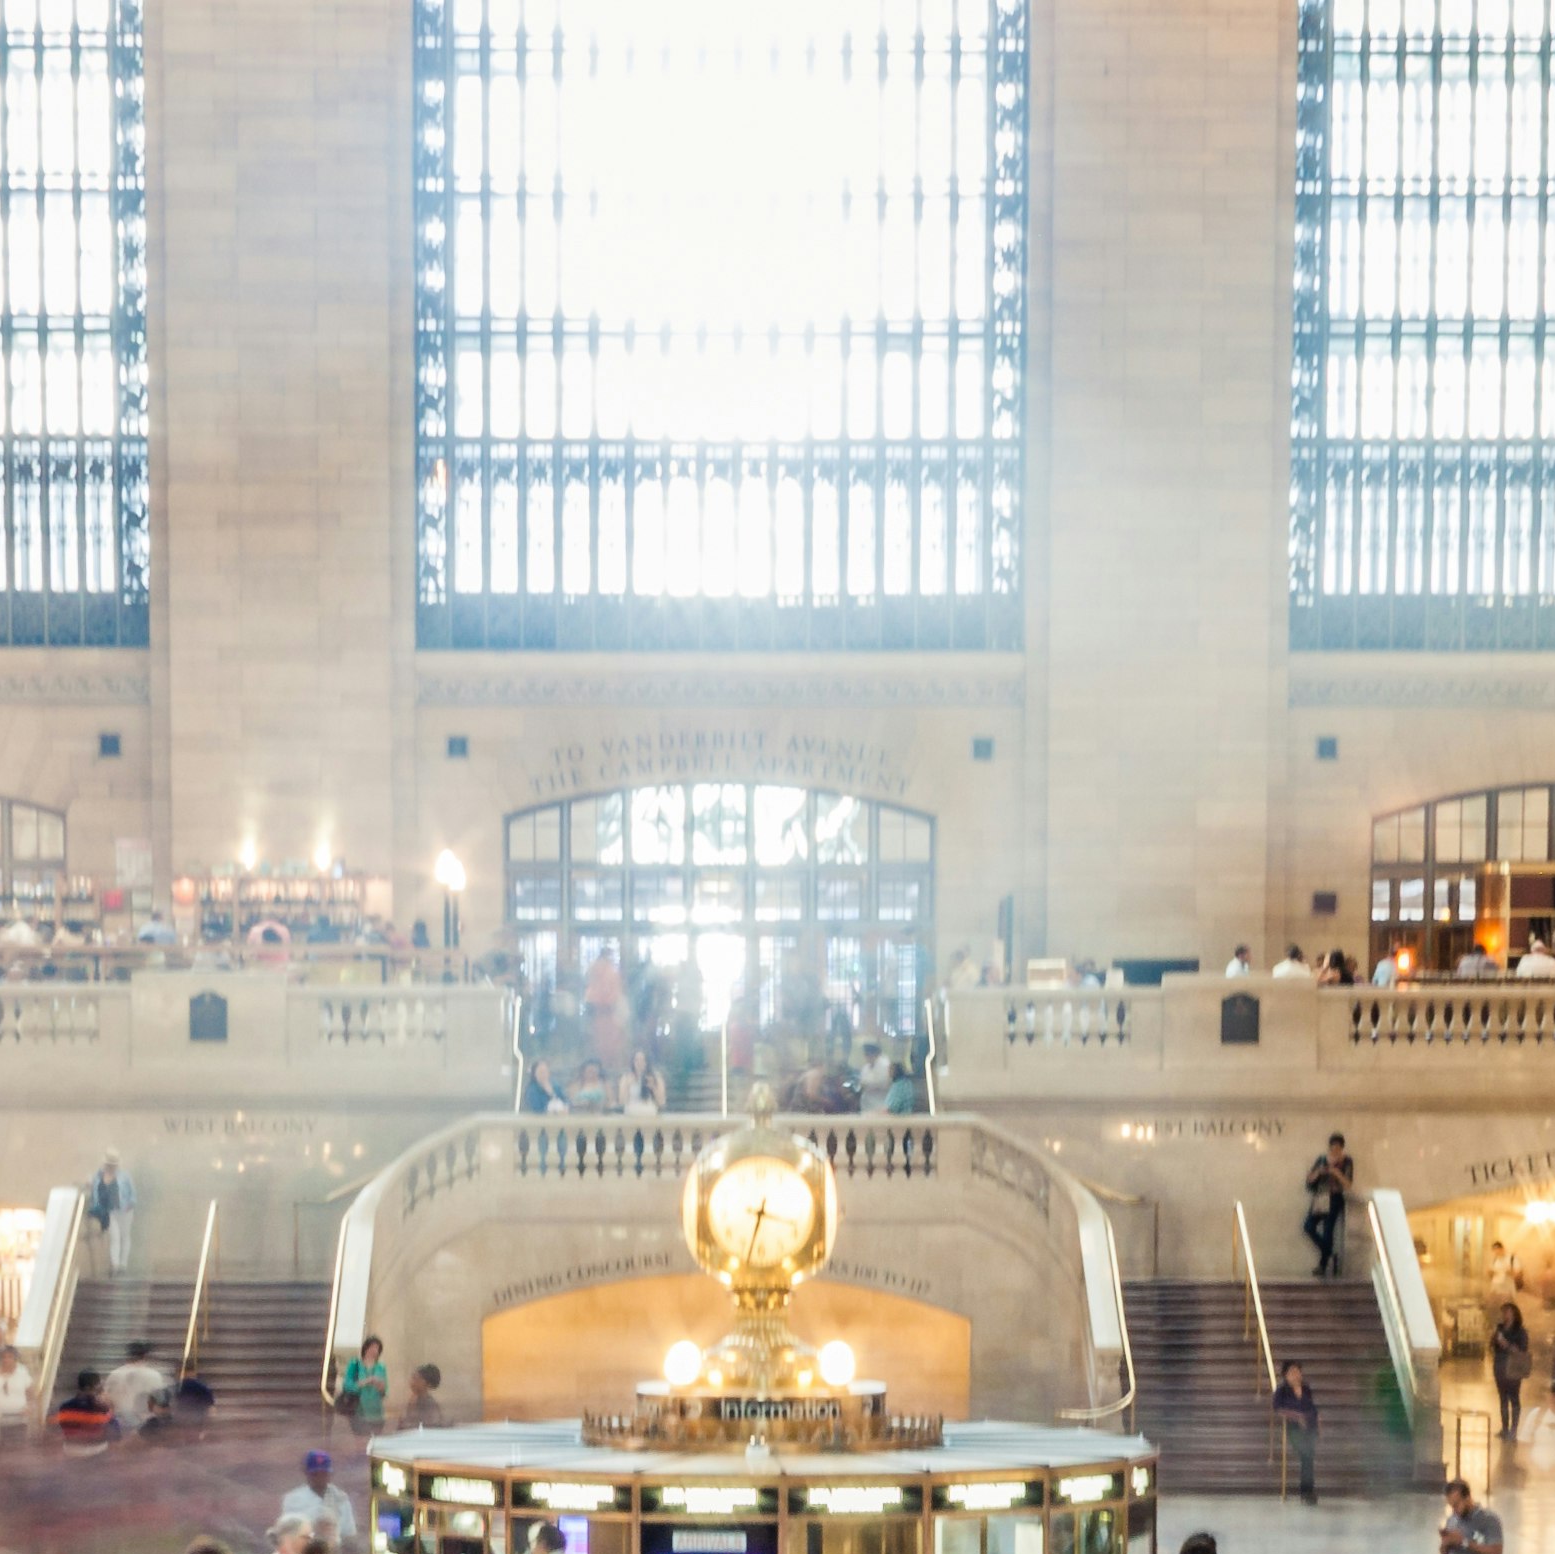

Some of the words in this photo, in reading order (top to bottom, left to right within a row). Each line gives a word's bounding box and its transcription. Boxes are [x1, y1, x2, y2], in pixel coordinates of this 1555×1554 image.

[553, 744, 585, 766] TO
[602, 730, 767, 757] VANDERBILT
[786, 734, 889, 766] AVENUE
[531, 768, 583, 795] THE
[600, 754, 734, 780] CAMPBELL
[754, 757, 911, 795] APARTMENT
[164, 1118, 215, 1134] WEST
[224, 1118, 317, 1134] BALCONY
[1194, 1119, 1284, 1136] BALCONY
[1465, 1151, 1555, 1186] TICKET
[493, 1273, 562, 1306] DINING
[567, 1252, 669, 1282] CONCOURSE
[721, 1397, 841, 1422] Information
